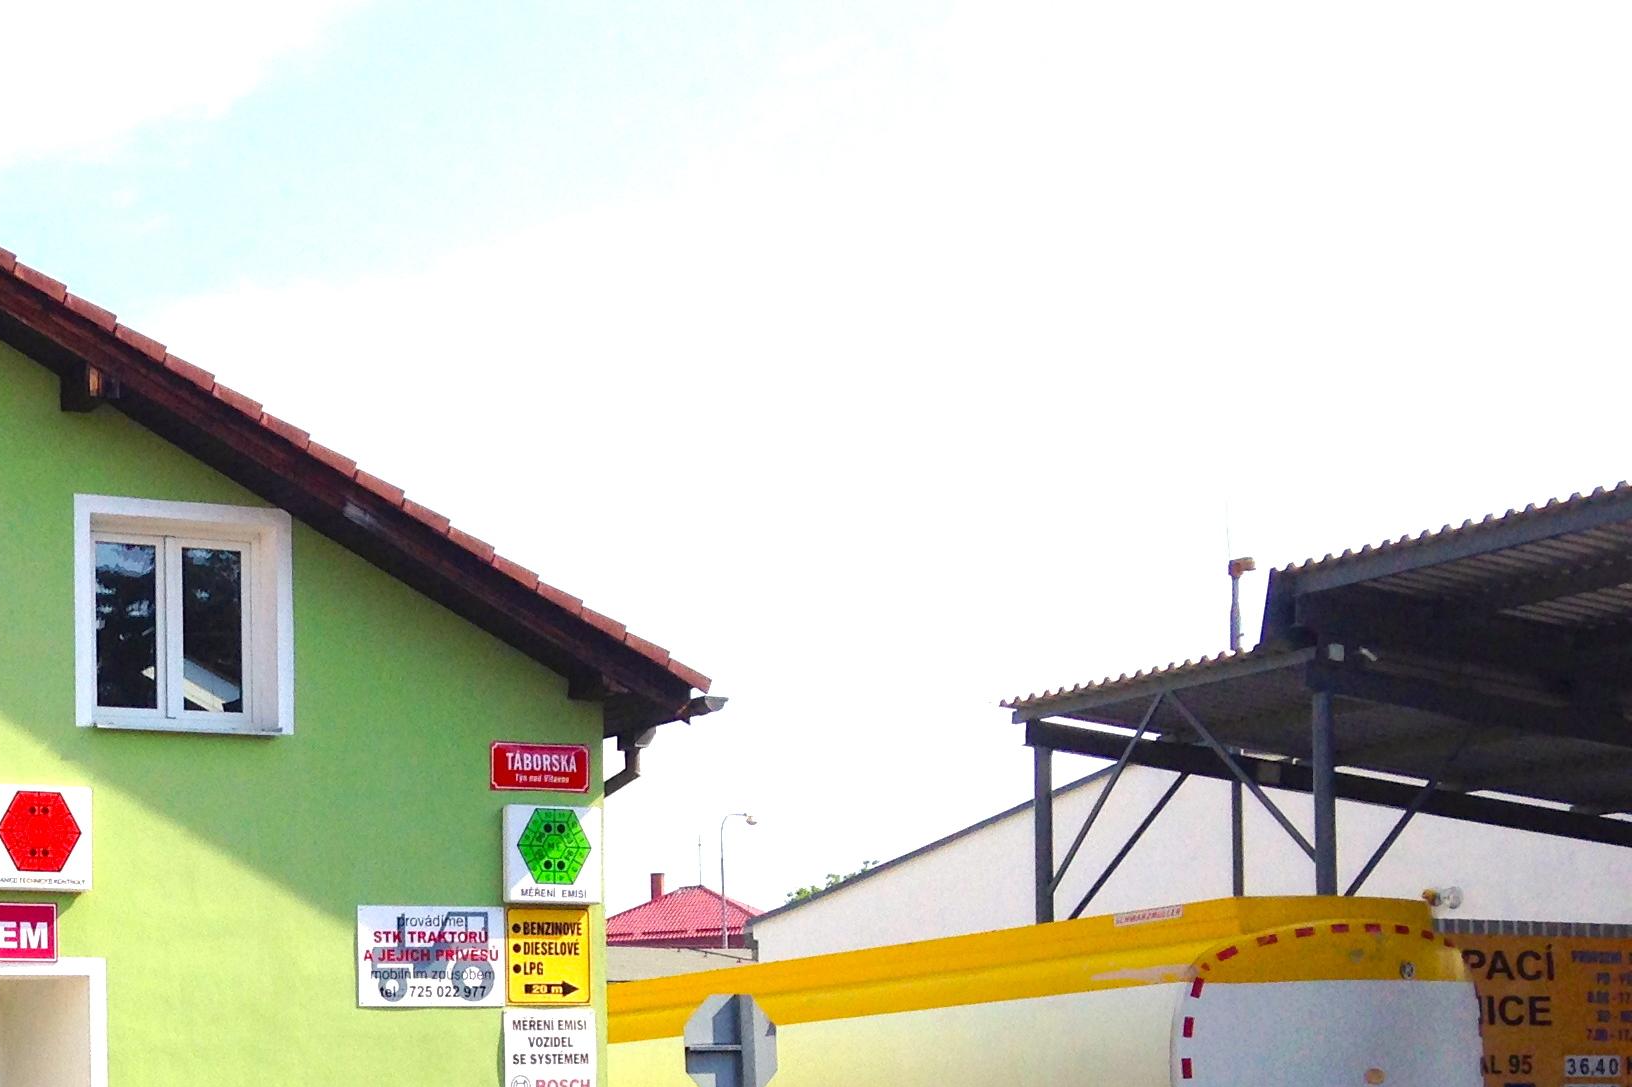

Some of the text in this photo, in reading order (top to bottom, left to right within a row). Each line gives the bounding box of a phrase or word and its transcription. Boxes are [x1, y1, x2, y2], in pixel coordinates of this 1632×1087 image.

[506, 750, 577, 773] TÁBORSKÁ
[397, 915, 464, 928] provádíme
[523, 920, 582, 936] BENZINOVÉ
[373, 929, 488, 944] STK TRAKTORŮ
[523, 940, 580, 956] DIESELOVÉ
[363, 950, 373, 961] A
[378, 949, 430, 962] JEJICH
[371, 967, 428, 979] mobilním
[523, 962, 543, 975] LPG
[410, 986, 432, 998] 725
[437, 986, 460, 998] 022
[464, 986, 487, 998] 977
[531, 984, 562, 994] 20 m
[528, 1036, 573, 1048] VOZIDEL
[513, 1051, 589, 1065] SE SYSTÉMEM
[1508, 1055, 1533, 1075] 95
